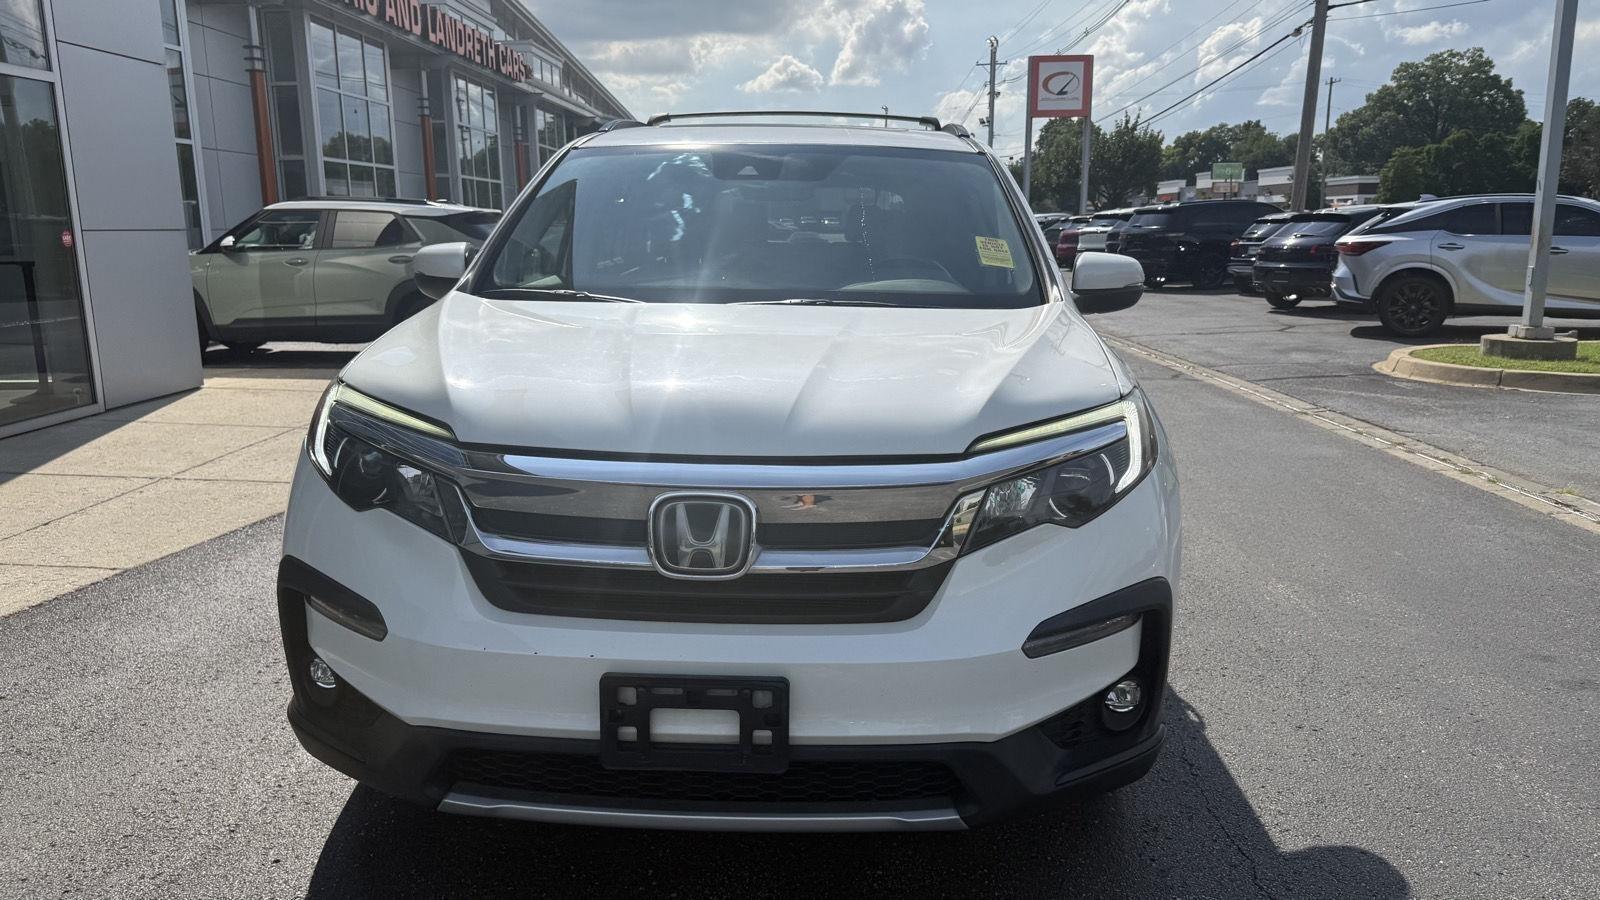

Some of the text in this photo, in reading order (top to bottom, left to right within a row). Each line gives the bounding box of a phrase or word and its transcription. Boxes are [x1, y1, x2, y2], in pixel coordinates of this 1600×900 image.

[385, 0, 422, 36] AND
[427, 4, 496, 70] LANDRETH
[499, 44, 526, 82] CARS
